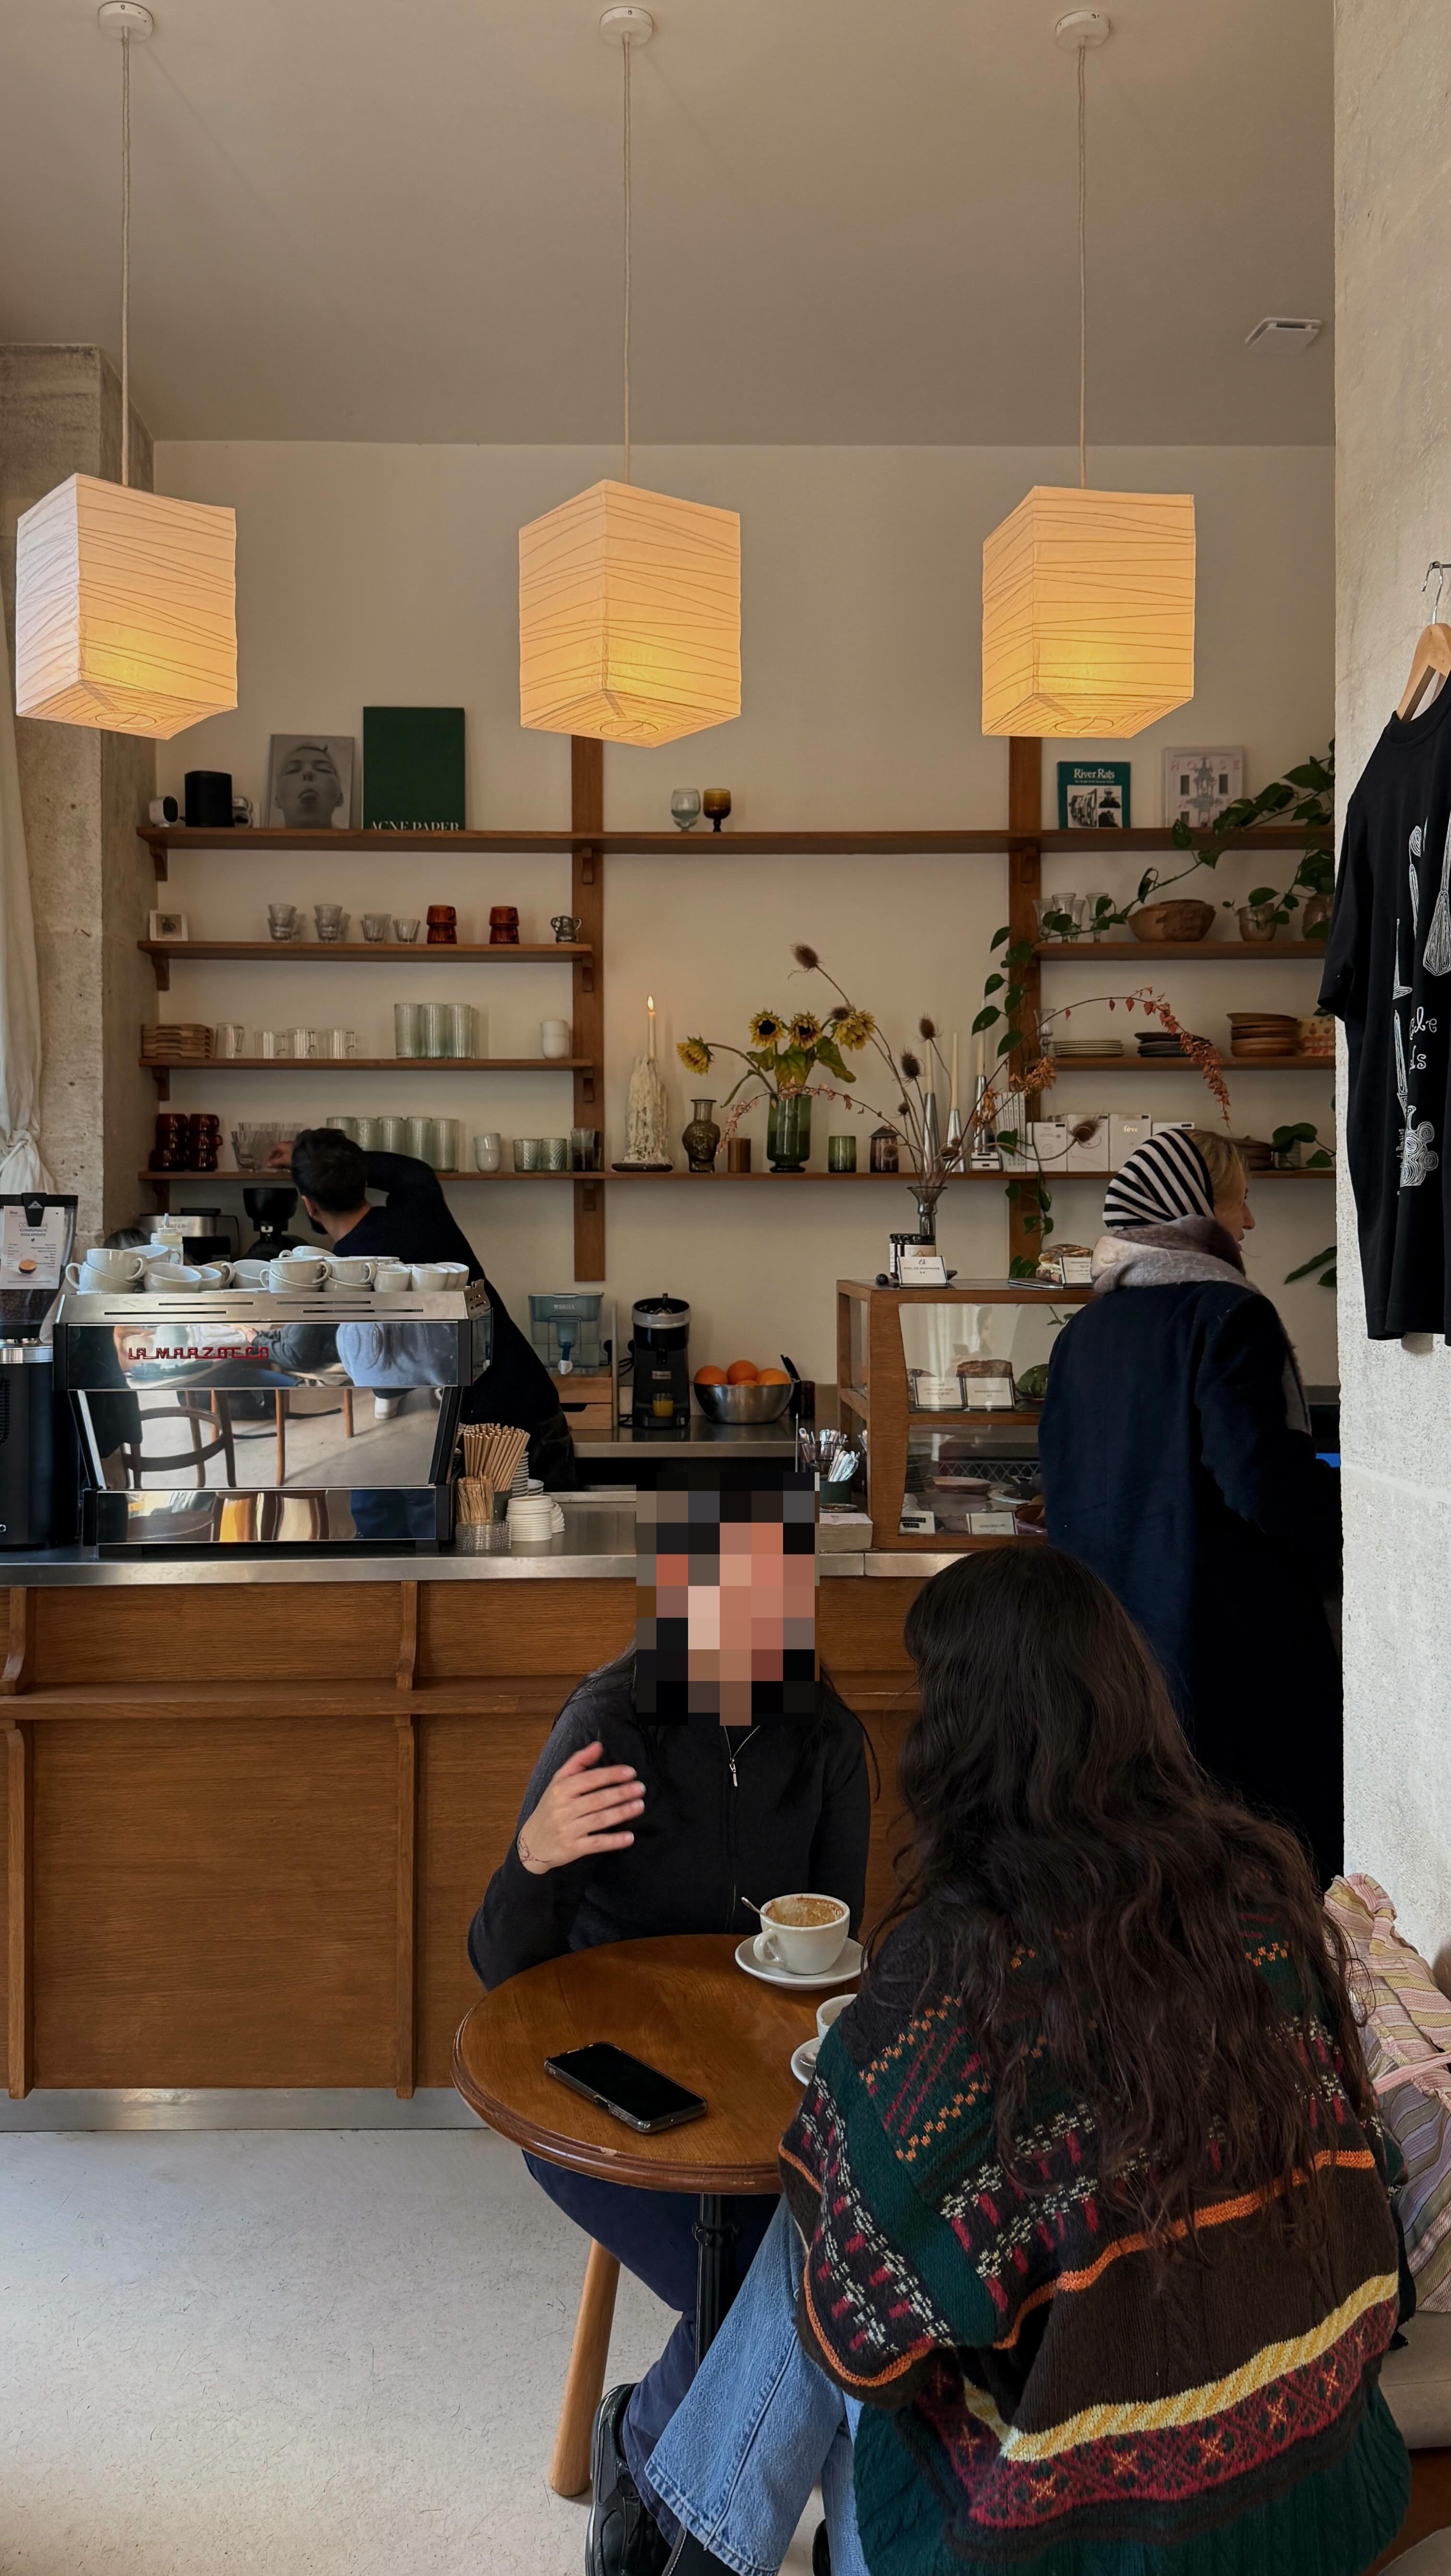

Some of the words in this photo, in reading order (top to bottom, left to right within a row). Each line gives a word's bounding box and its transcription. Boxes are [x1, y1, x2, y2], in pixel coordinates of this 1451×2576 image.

[1074, 768, 1096, 778] River
[1097, 768, 1115, 779] Rats
[129, 1347, 146, 1359] LA
